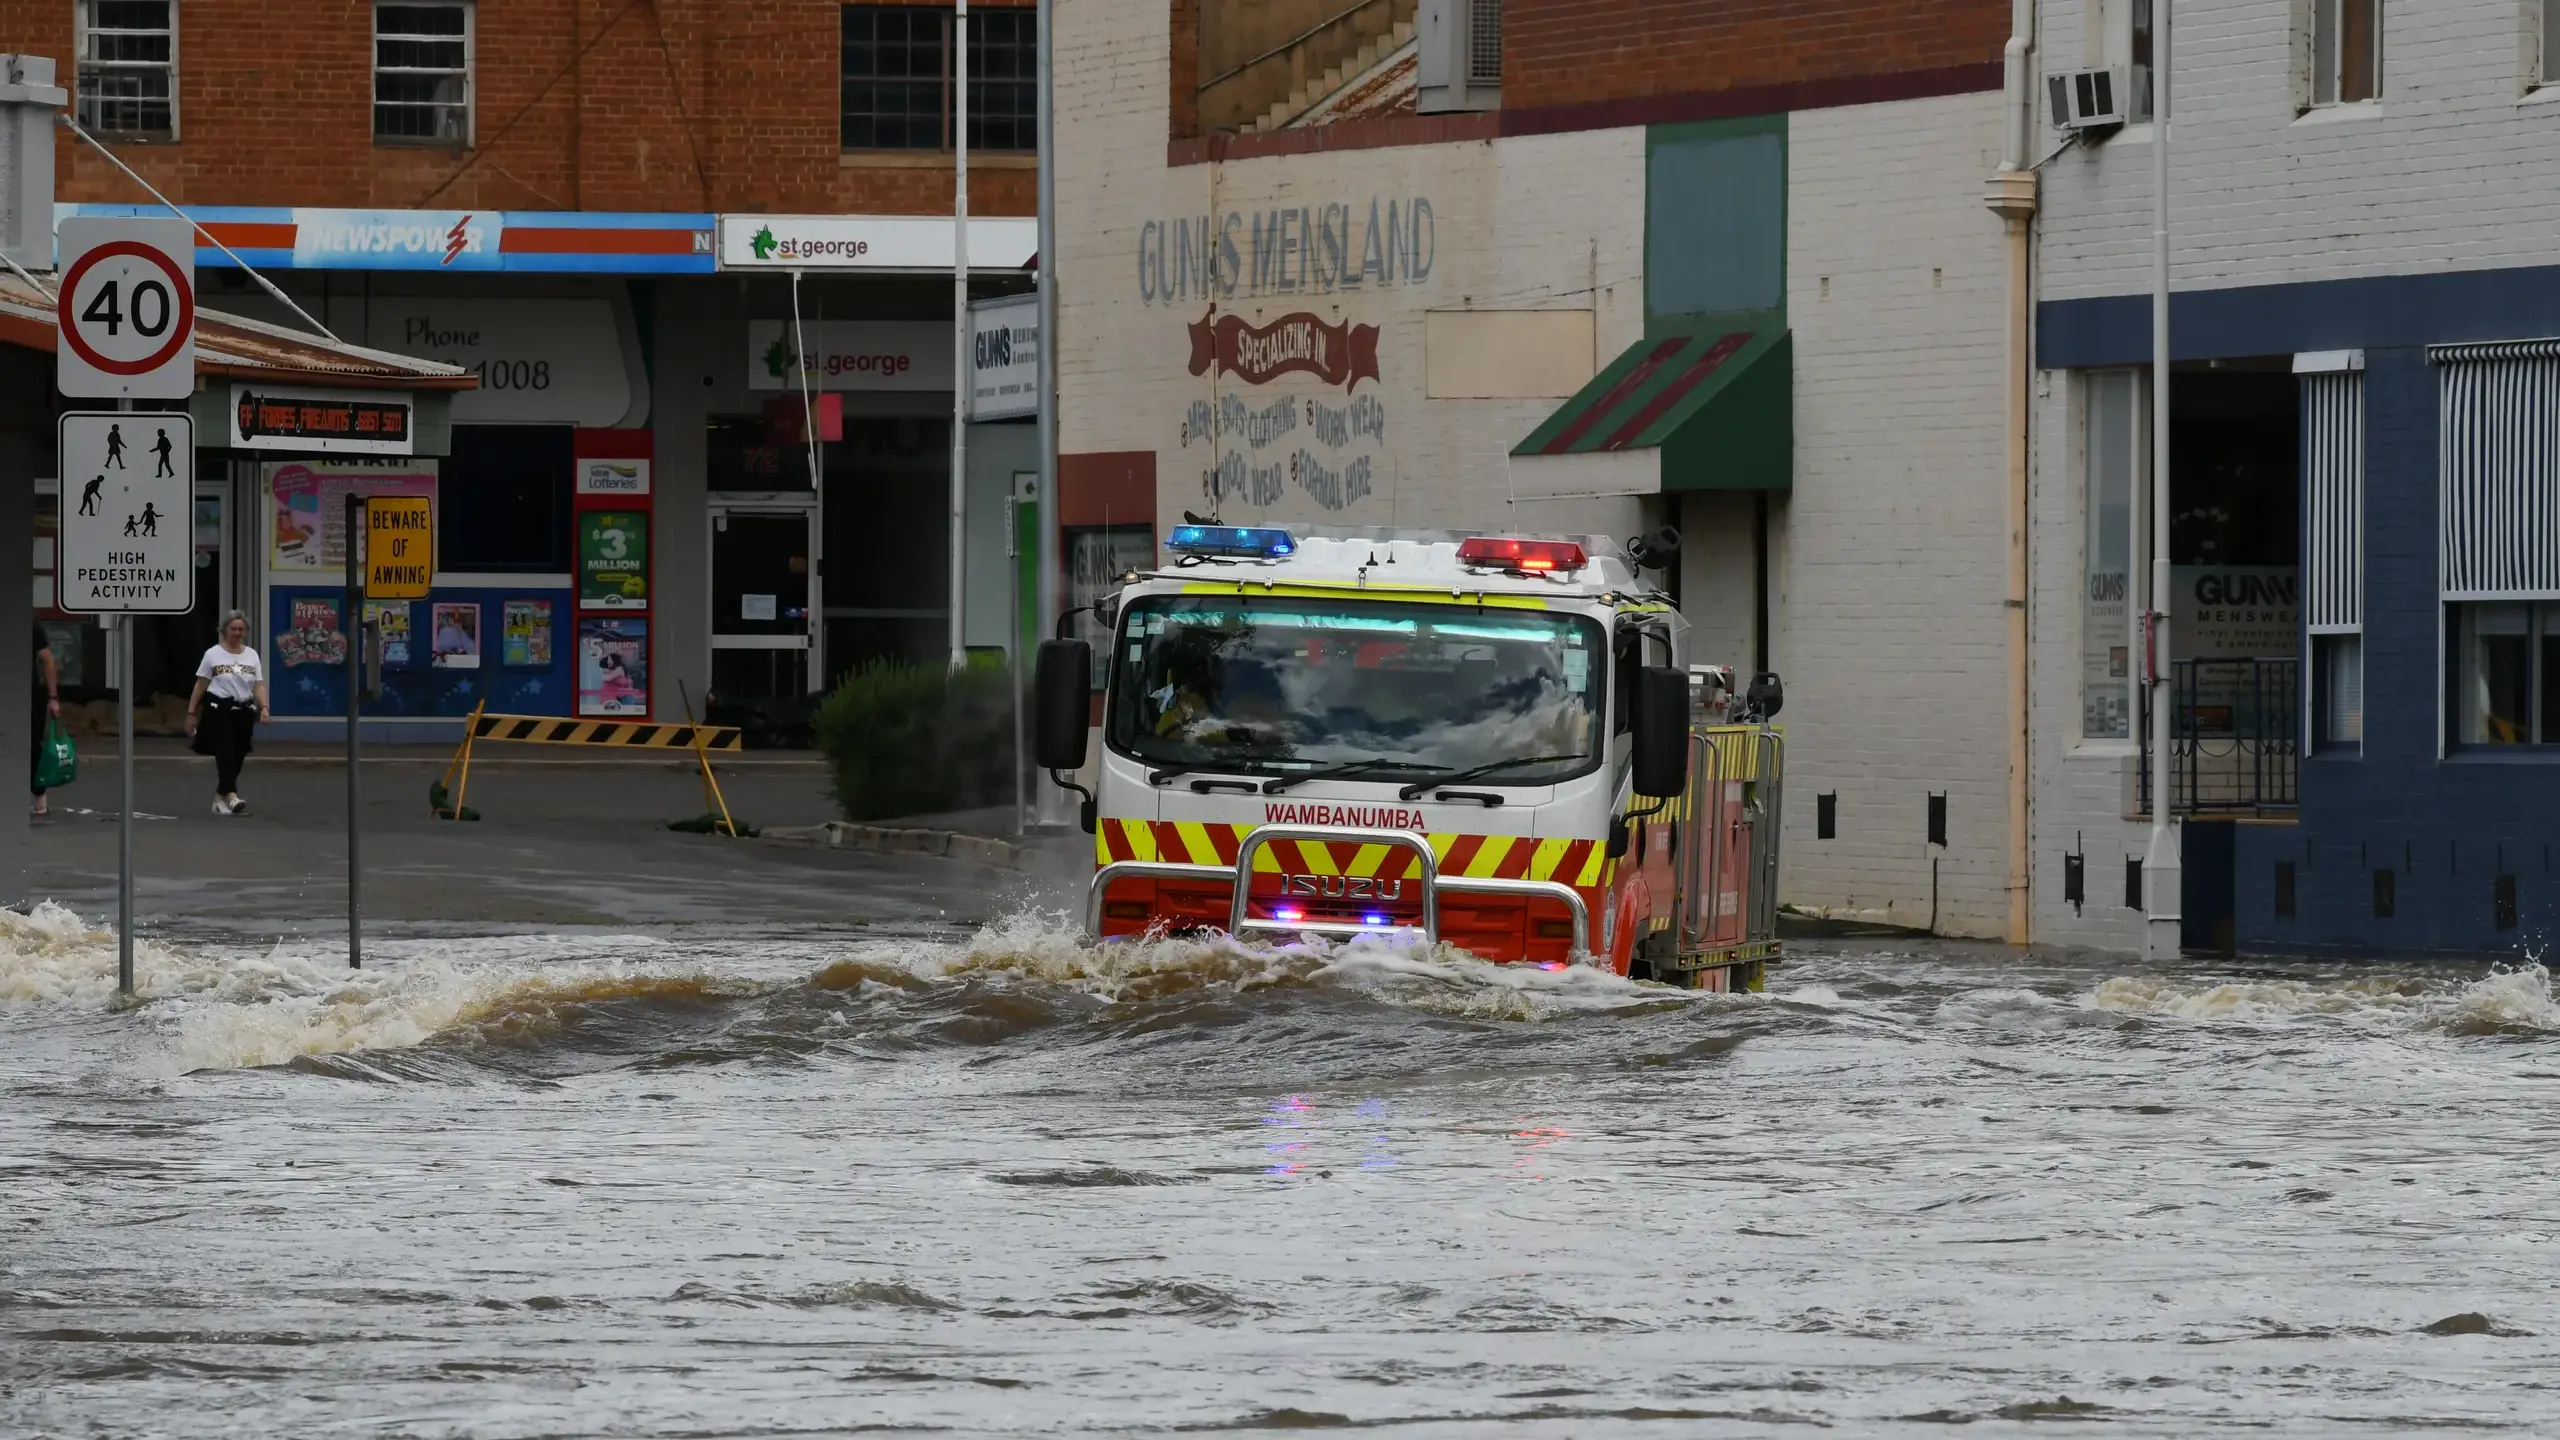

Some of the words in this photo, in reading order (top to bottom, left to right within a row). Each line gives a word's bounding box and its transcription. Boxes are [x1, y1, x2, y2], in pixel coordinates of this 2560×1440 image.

[779, 238, 868, 258] st.george
[1251, 195, 1435, 294] MENSLAND
[82, 280, 171, 337] 40
[404, 316, 480, 347] Phone
[1237, 322, 1312, 374] SPECIALIZING
[473, 360, 550, 390] 1008
[802, 350, 910, 375] st.george
[1248, 394, 1297, 449] CLOTHING
[1315, 400, 1349, 448] WORK
[1350, 393, 1384, 448] WEAR
[588, 477, 638, 490] Lotteries
[1252, 461, 1284, 507] WEAR
[1298, 448, 1343, 510] FORMAL
[1345, 455, 1371, 506] HIRE
[373, 511, 426, 529] BEWARE
[107, 552, 146, 566] HIGH
[392, 538, 409, 557] OF
[78, 569, 176, 582] PEDESTRIAN
[374, 564, 425, 585] AWNING
[587, 560, 641, 571] MILLION
[90, 585, 162, 599] ACTIVITY
[2195, 575, 2299, 606] GUNN
[1265, 803, 1425, 829] WAMBANUMBA
[1280, 873, 1402, 900] ISUZU
